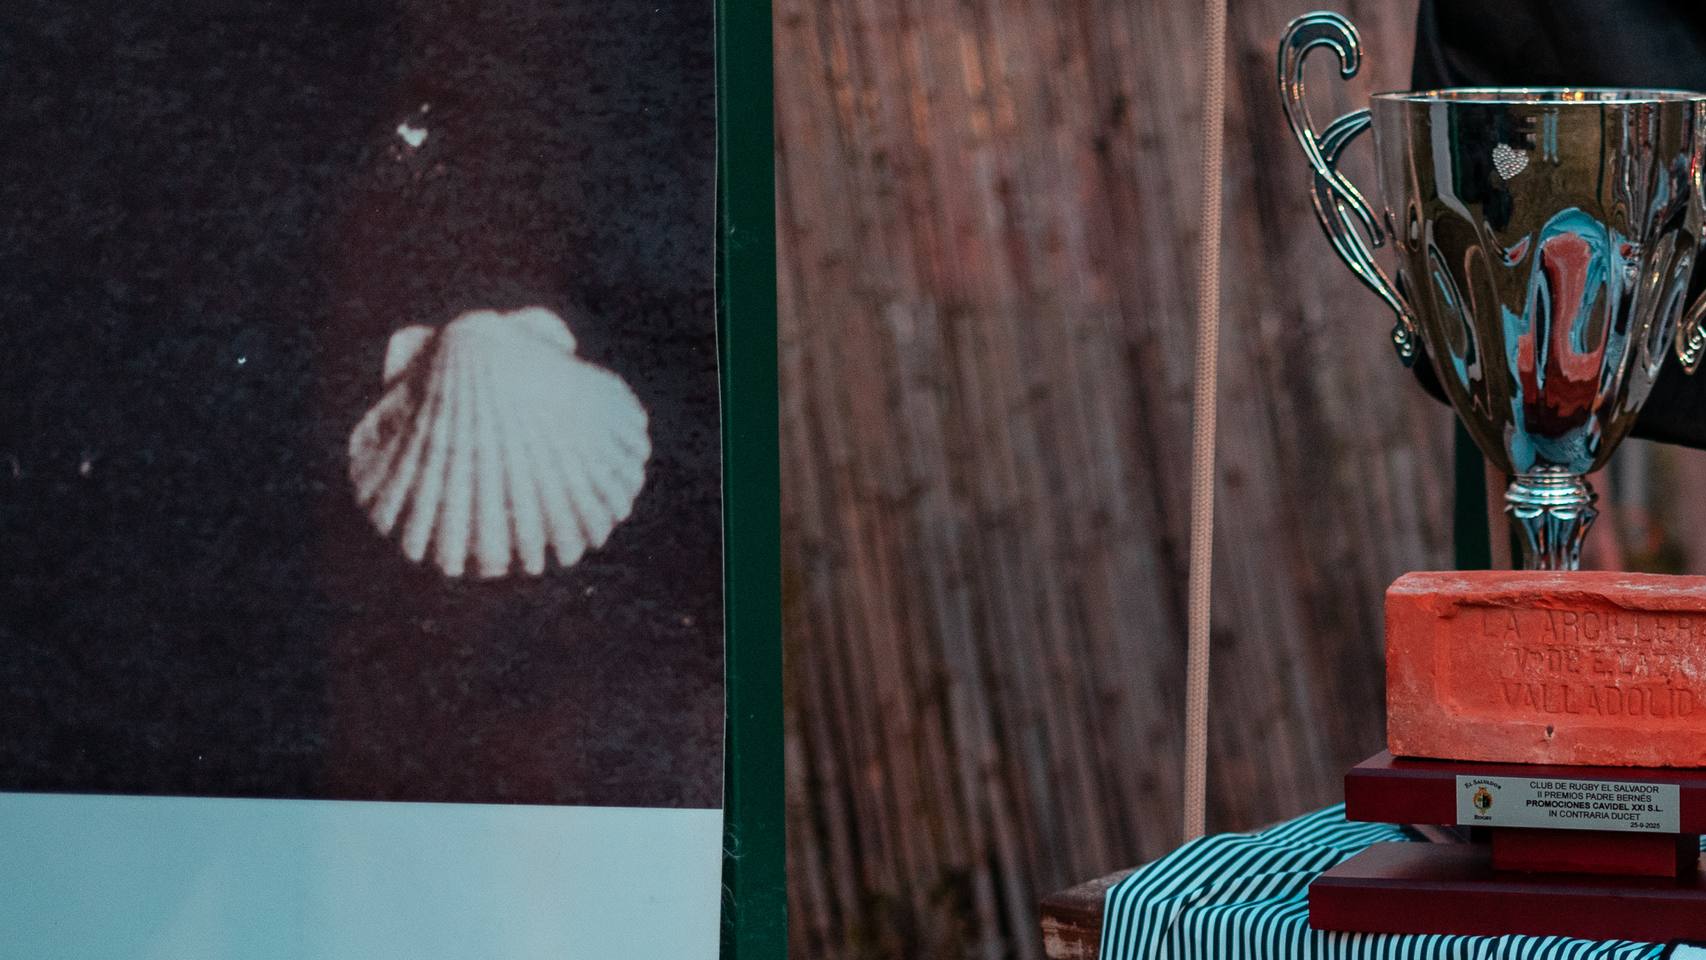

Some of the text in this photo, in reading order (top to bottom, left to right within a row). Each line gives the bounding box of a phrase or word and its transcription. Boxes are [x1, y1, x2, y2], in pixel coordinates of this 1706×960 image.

[1481, 609, 1523, 639] LA
[1502, 682, 1695, 718] VALLADOLID
[1529, 781, 1660, 793] CLUB DE RUGBY EL SALVADOR
[1544, 791, 1584, 800] PREMIOS
[1585, 792, 1615, 801] PADRE
[1525, 800, 1664, 812] PROMOCIONES CAVIDEL XXI S.L.
[1559, 810, 1609, 820] CONTRARIA
[1611, 812, 1641, 821] DUCET
